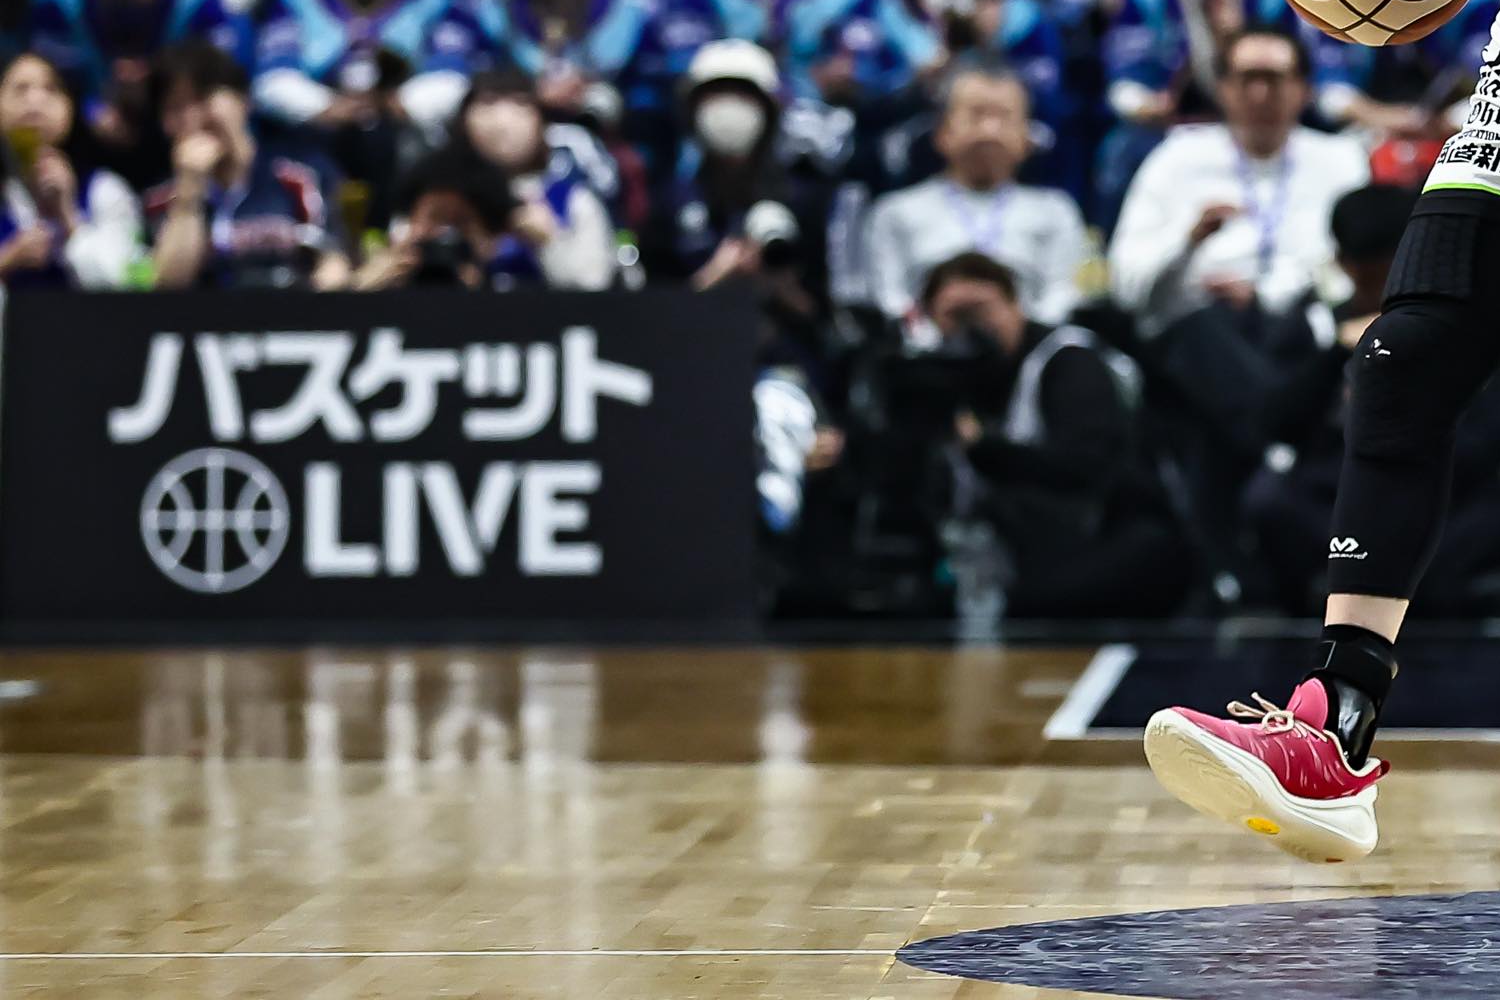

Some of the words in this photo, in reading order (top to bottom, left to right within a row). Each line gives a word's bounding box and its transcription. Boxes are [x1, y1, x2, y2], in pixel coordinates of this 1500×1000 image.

[108, 326, 653, 443] バスケット
[305, 460, 602, 576] LIVE
